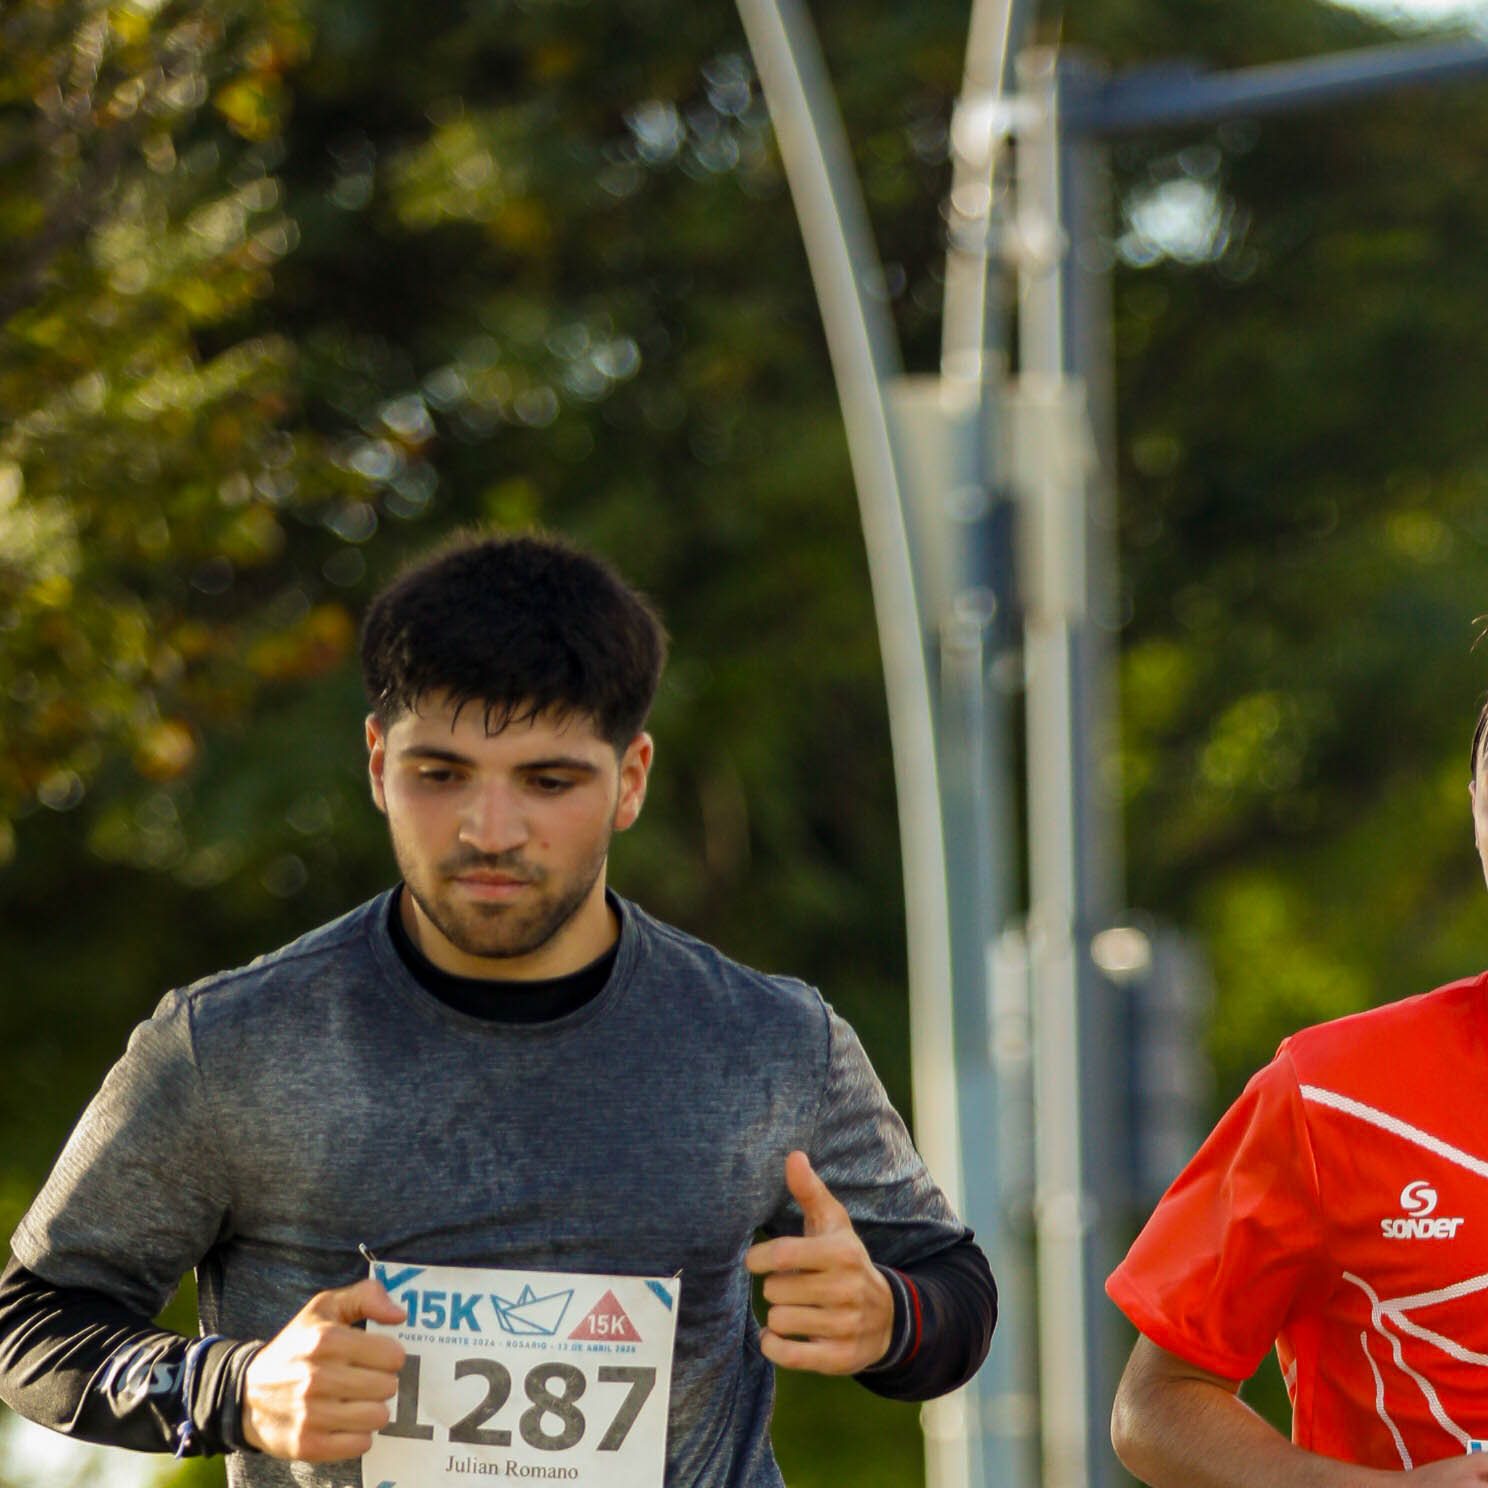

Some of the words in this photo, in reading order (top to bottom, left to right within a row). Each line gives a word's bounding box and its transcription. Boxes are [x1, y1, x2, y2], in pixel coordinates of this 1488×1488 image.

[400, 1289, 484, 1332] 15K
[588, 1314, 626, 1335] 15K
[398, 1332, 434, 1343] PUERTO
[438, 1336, 469, 1345] NORTE
[506, 1340, 547, 1350] ROSARIO
[571, 1343, 584, 1352] DE
[586, 1344, 612, 1353] ABRIL
[378, 1354, 657, 1452] 1287
[445, 1455, 499, 1476] Julian
[504, 1461, 579, 1480] Romano
